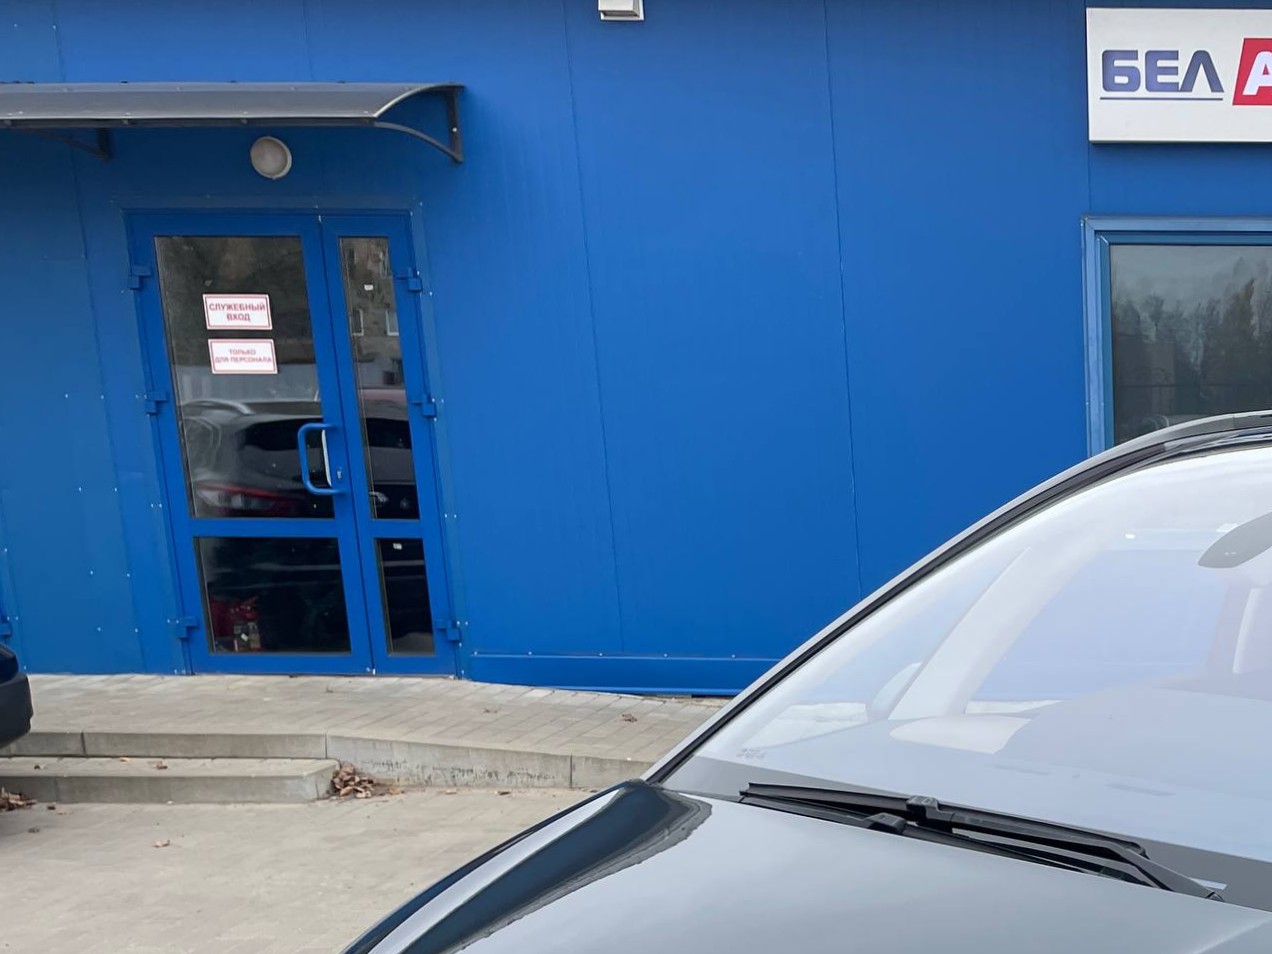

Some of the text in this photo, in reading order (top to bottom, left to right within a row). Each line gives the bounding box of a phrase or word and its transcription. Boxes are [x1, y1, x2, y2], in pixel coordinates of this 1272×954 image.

[1101, 49, 1224, 93] БЕЛ
[209, 302, 265, 312] СЛУЖЕБНЫЙ
[226, 313, 251, 321] ВХОД
